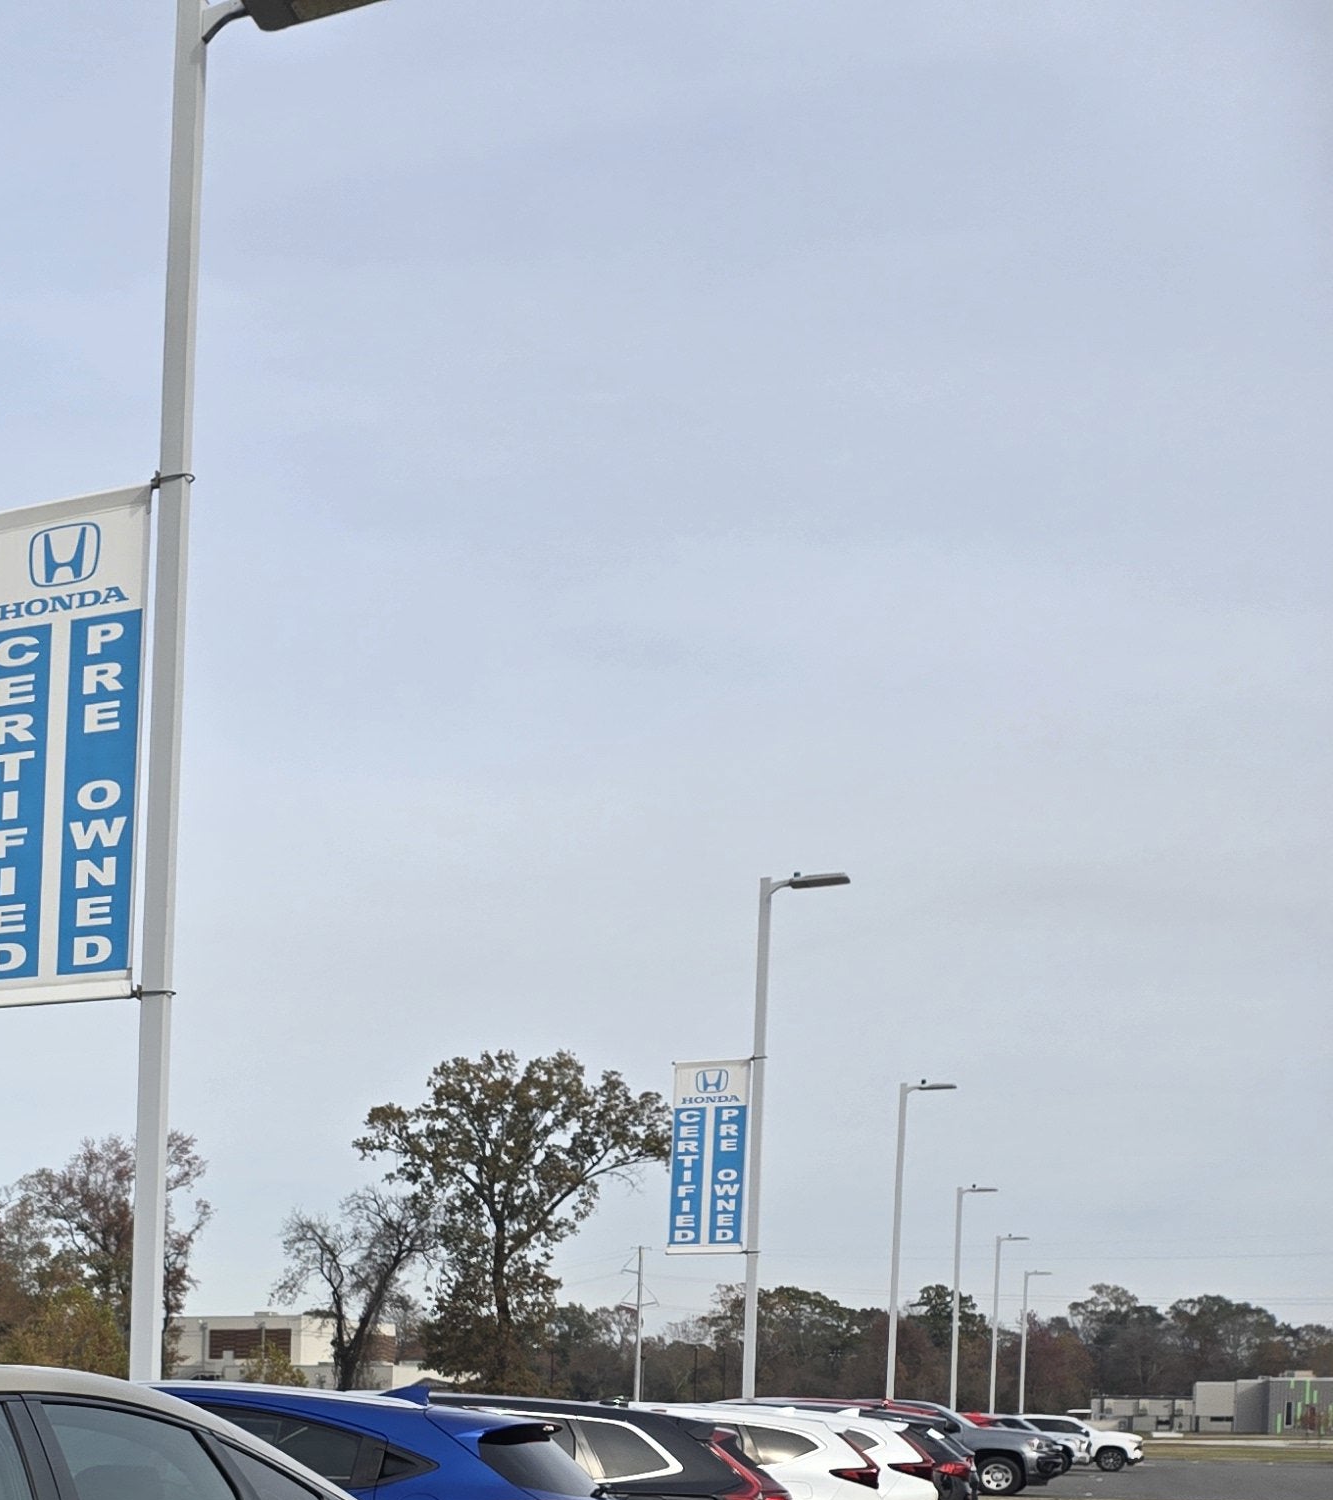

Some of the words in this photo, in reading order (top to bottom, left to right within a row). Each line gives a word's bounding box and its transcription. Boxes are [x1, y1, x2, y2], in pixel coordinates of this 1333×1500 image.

[81, 622, 125, 734] PRE
[68, 778, 128, 967] OWNED
[681, 1094, 741, 1105] HONDA
[719, 1108, 740, 1152] PRE
[673, 1110, 702, 1243] CERTIFIED
[713, 1168, 741, 1242] OWNED
